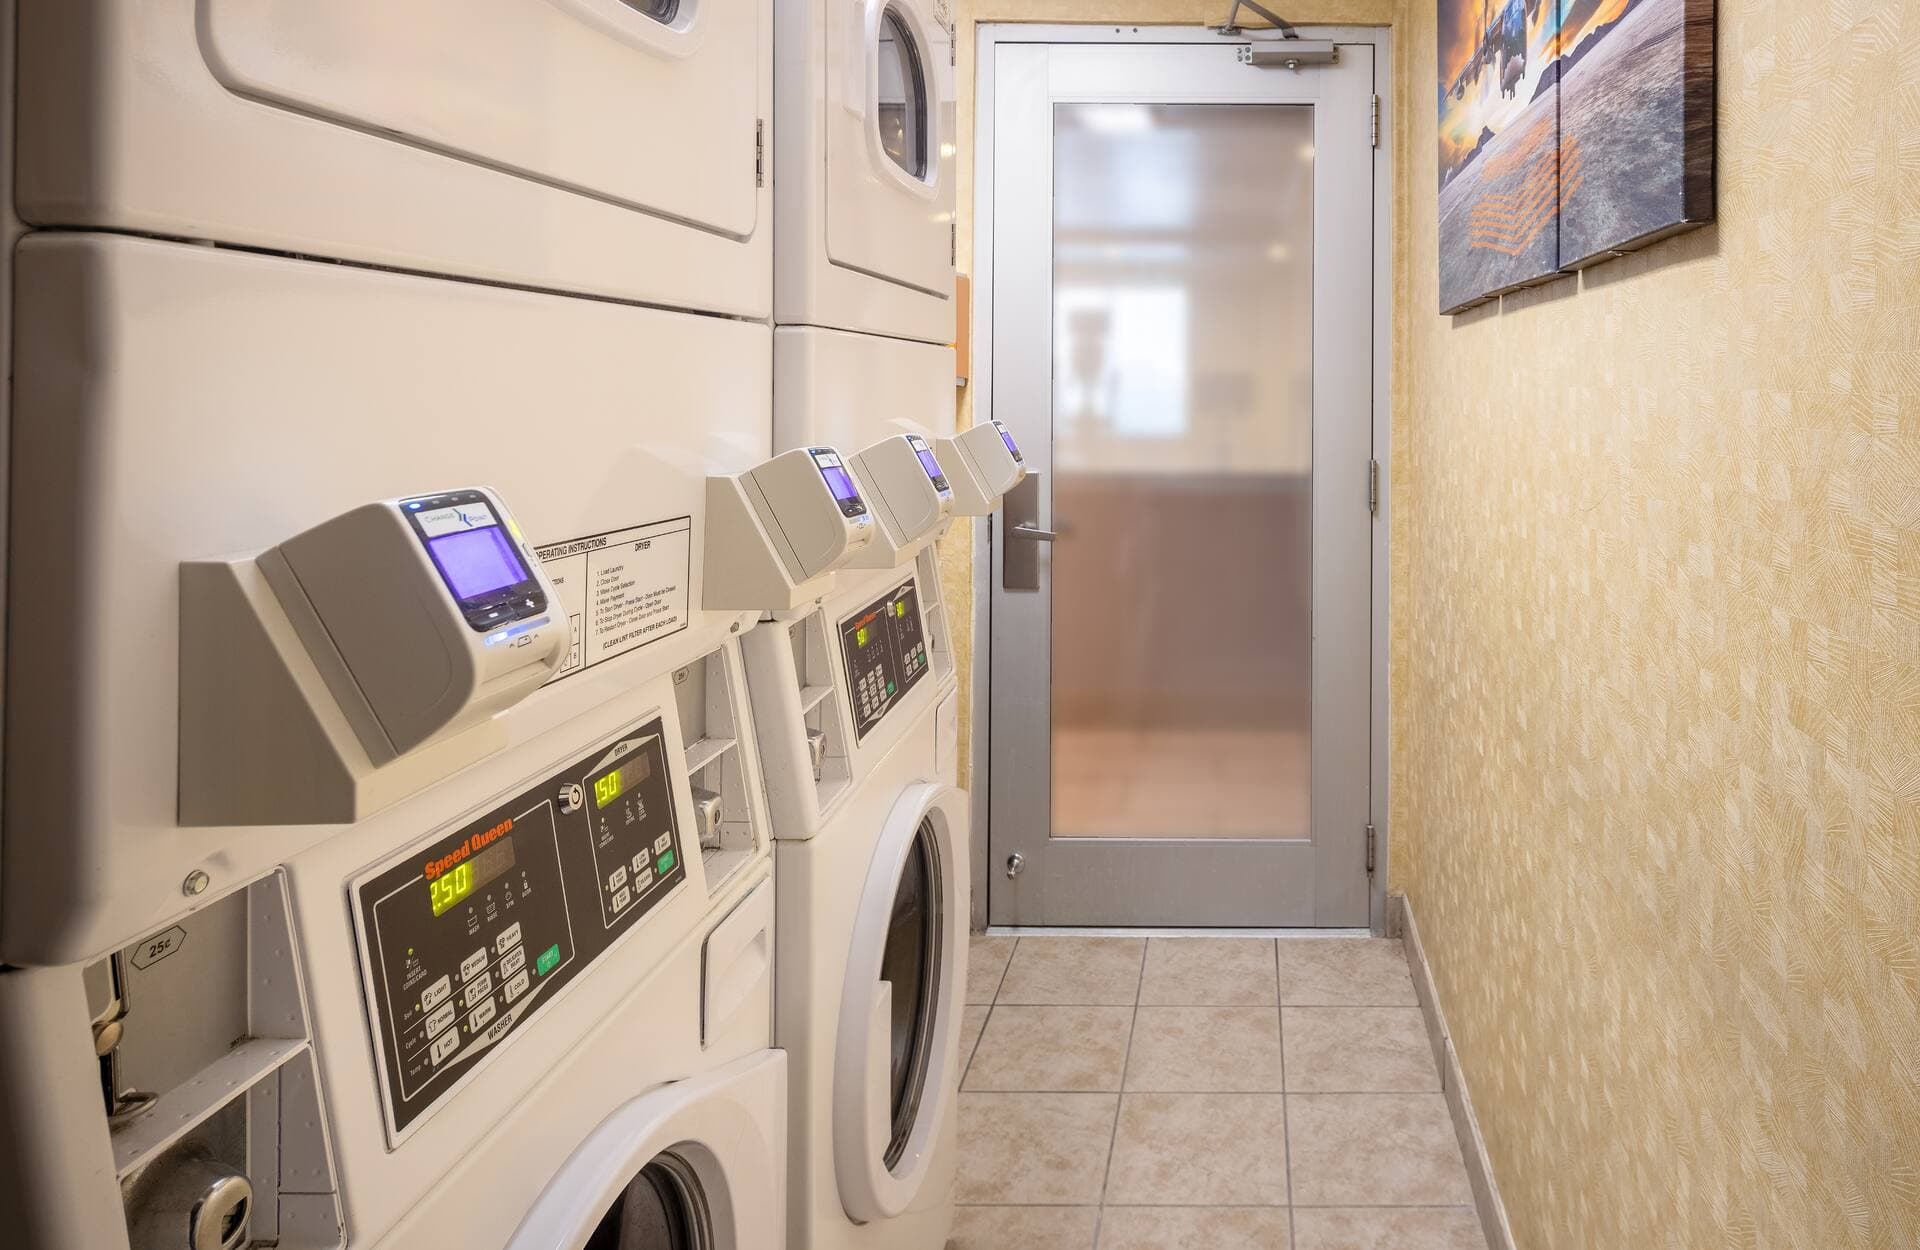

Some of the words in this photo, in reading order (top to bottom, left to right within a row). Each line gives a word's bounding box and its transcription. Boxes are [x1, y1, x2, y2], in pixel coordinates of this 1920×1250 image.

[568, 536, 607, 554] INSTRUCTIONS
[634, 540, 651, 552] DRYER
[614, 744, 628, 756] DRYER
[424, 840, 471, 880] Speed
[472, 818, 513, 851] Queen
[506, 929, 519, 942] HEAVY
[149, 939, 171, 958] 25¢
[433, 983, 448, 997] LIGHT
[514, 978, 525, 991] COLD
[438, 1010, 453, 1024] NORMAL
[487, 1013, 513, 1041] WASHER
[443, 1038, 453, 1050] HOT
